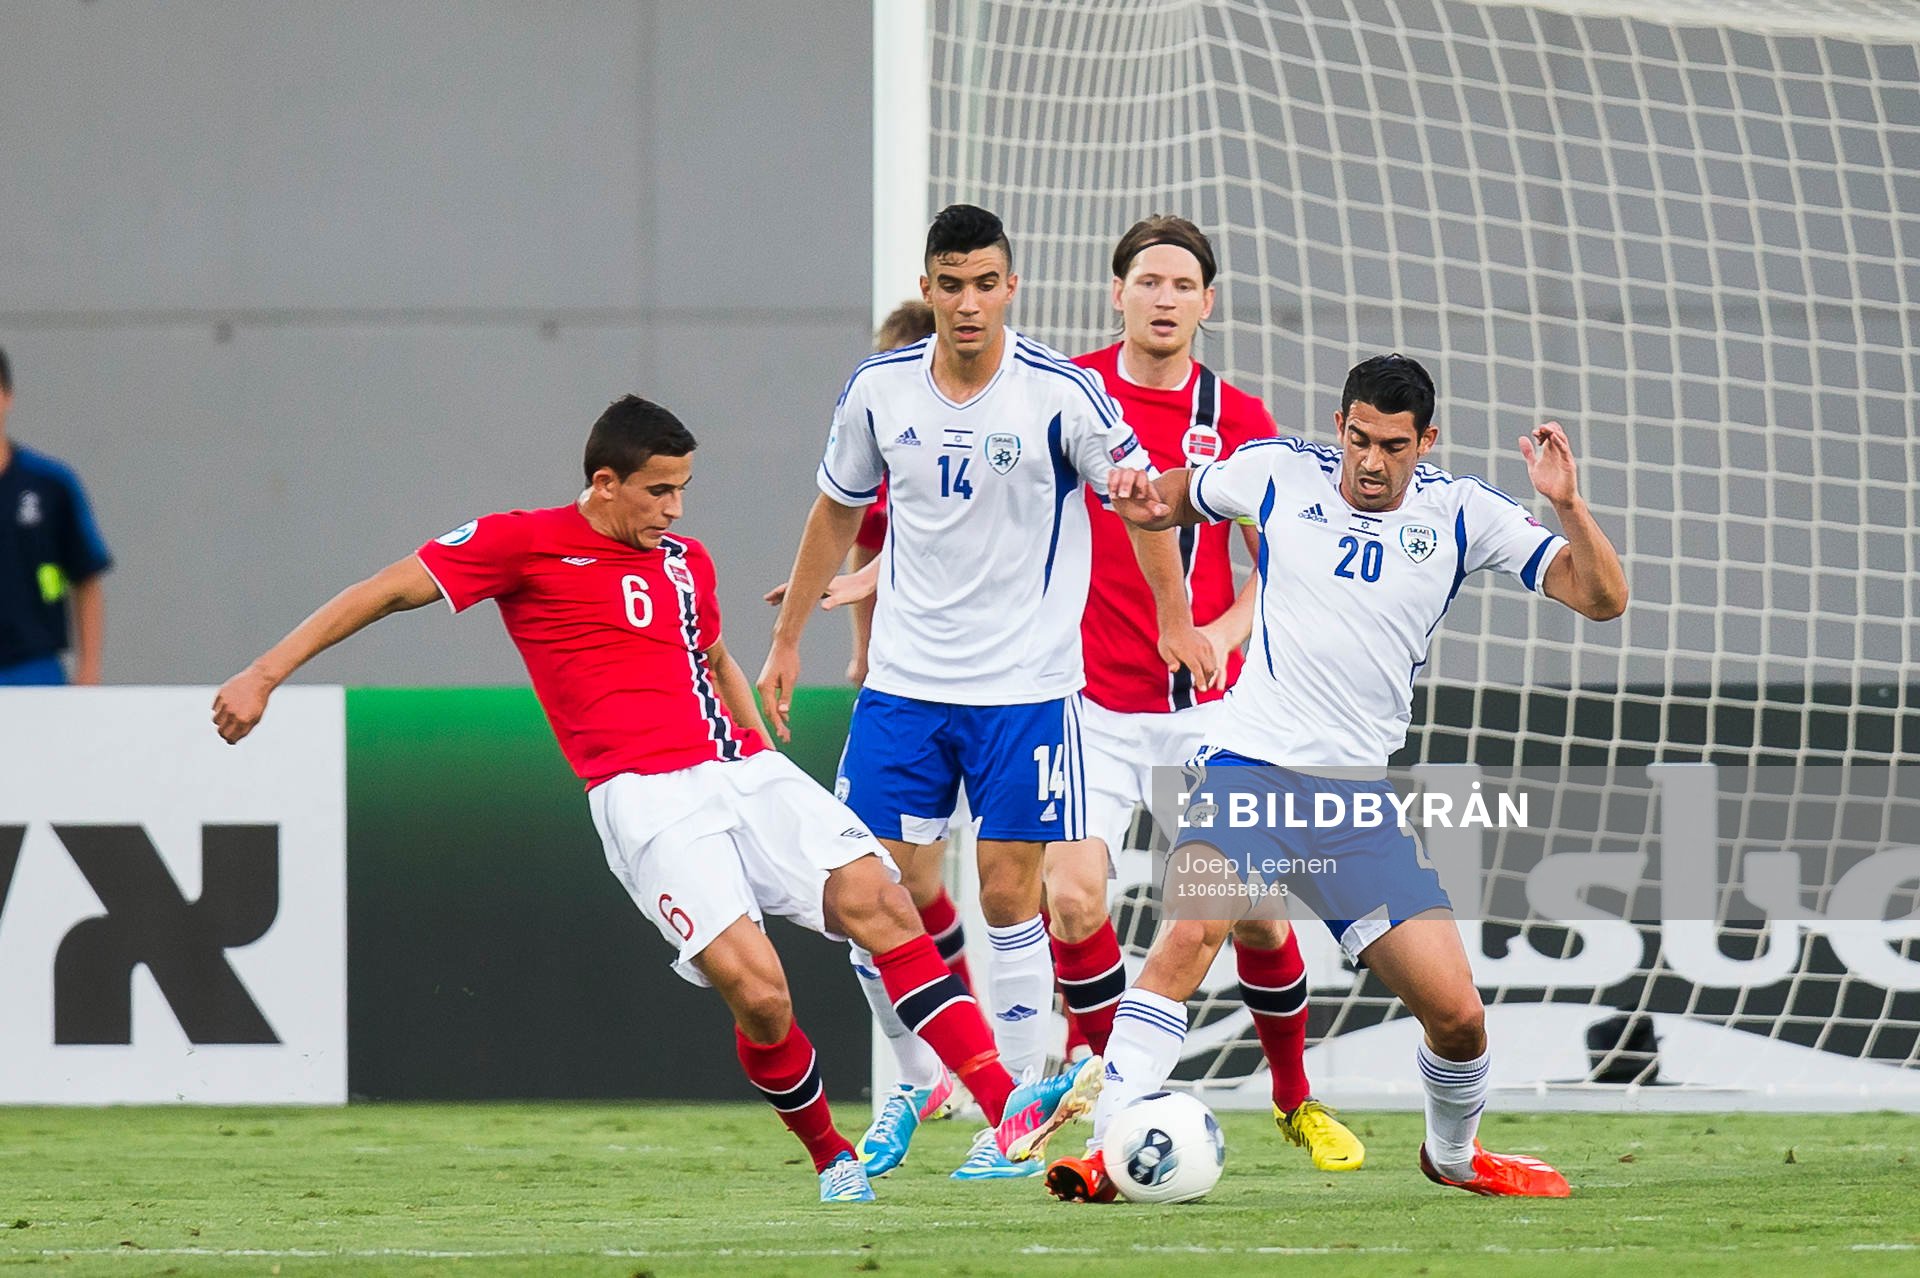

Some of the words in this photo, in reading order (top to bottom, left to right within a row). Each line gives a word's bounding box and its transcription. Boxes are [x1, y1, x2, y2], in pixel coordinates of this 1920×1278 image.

[937, 455, 973, 499] 14
[1334, 535, 1384, 583] 20
[621, 574, 654, 628] 6
[1033, 744, 1064, 801] 14
[658, 893, 695, 941] 6
